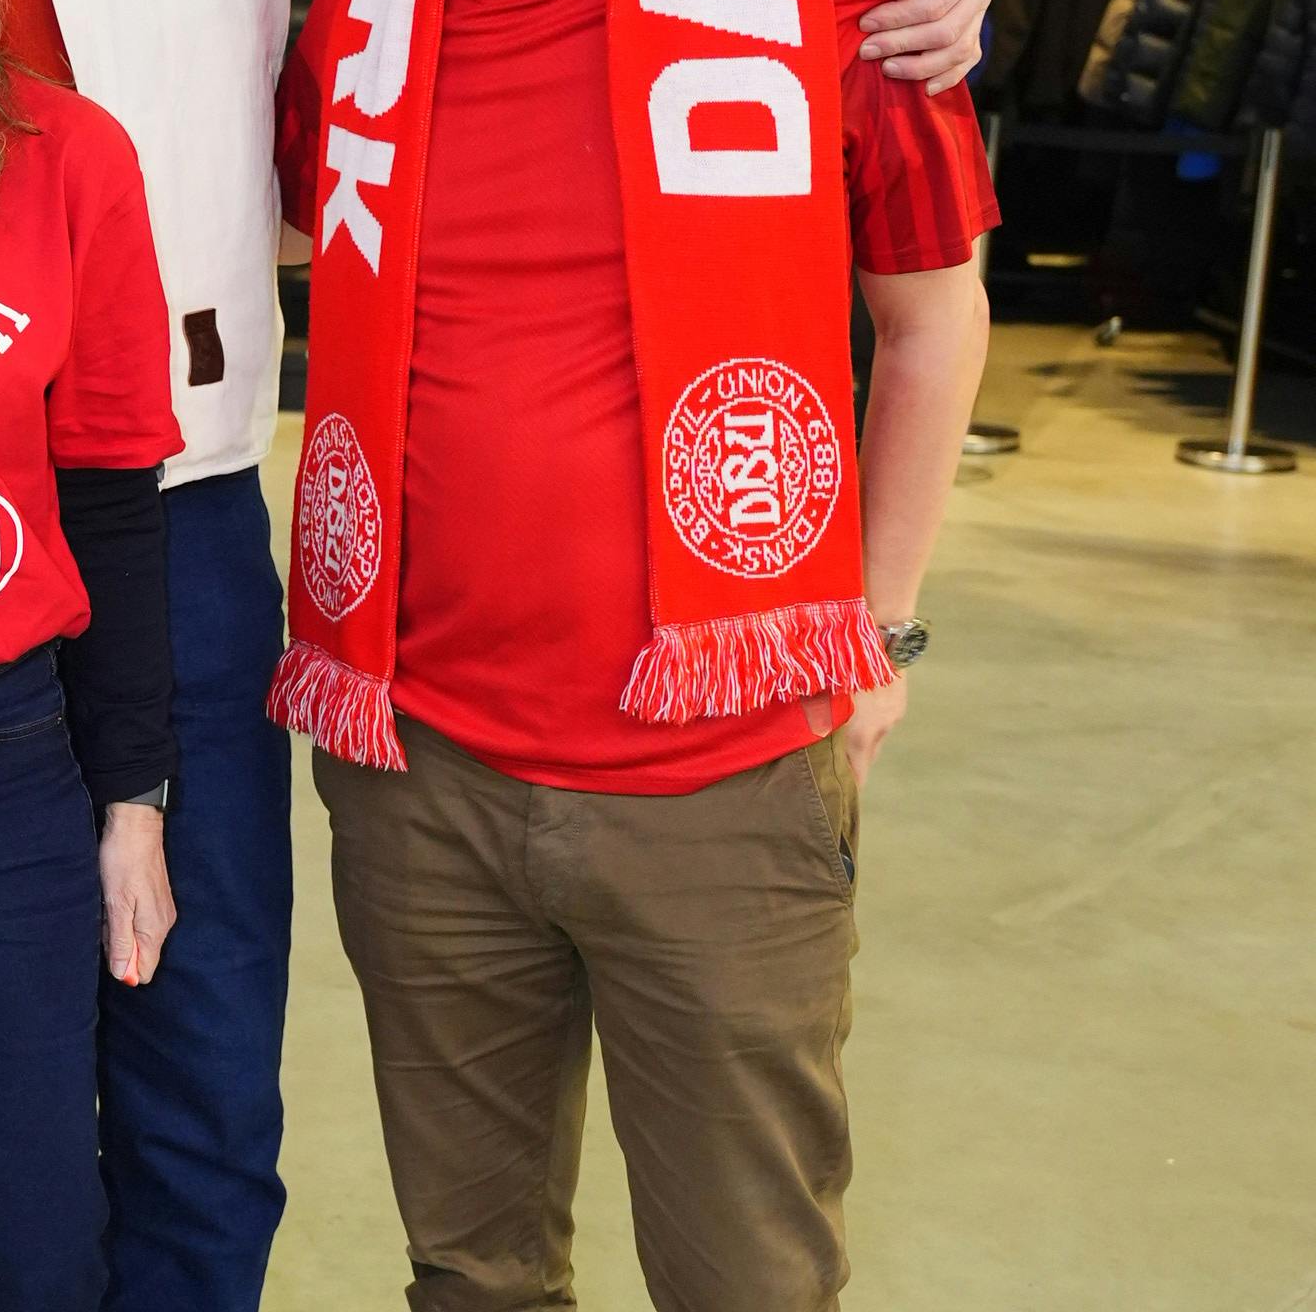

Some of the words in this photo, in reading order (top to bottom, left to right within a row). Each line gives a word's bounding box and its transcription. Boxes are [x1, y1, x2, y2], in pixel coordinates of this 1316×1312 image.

[314, 420, 353, 464] DANSK
[300, 471, 315, 548] 1889
[722, 515, 815, 571] DANSK
[807, 419, 836, 500] 1889
